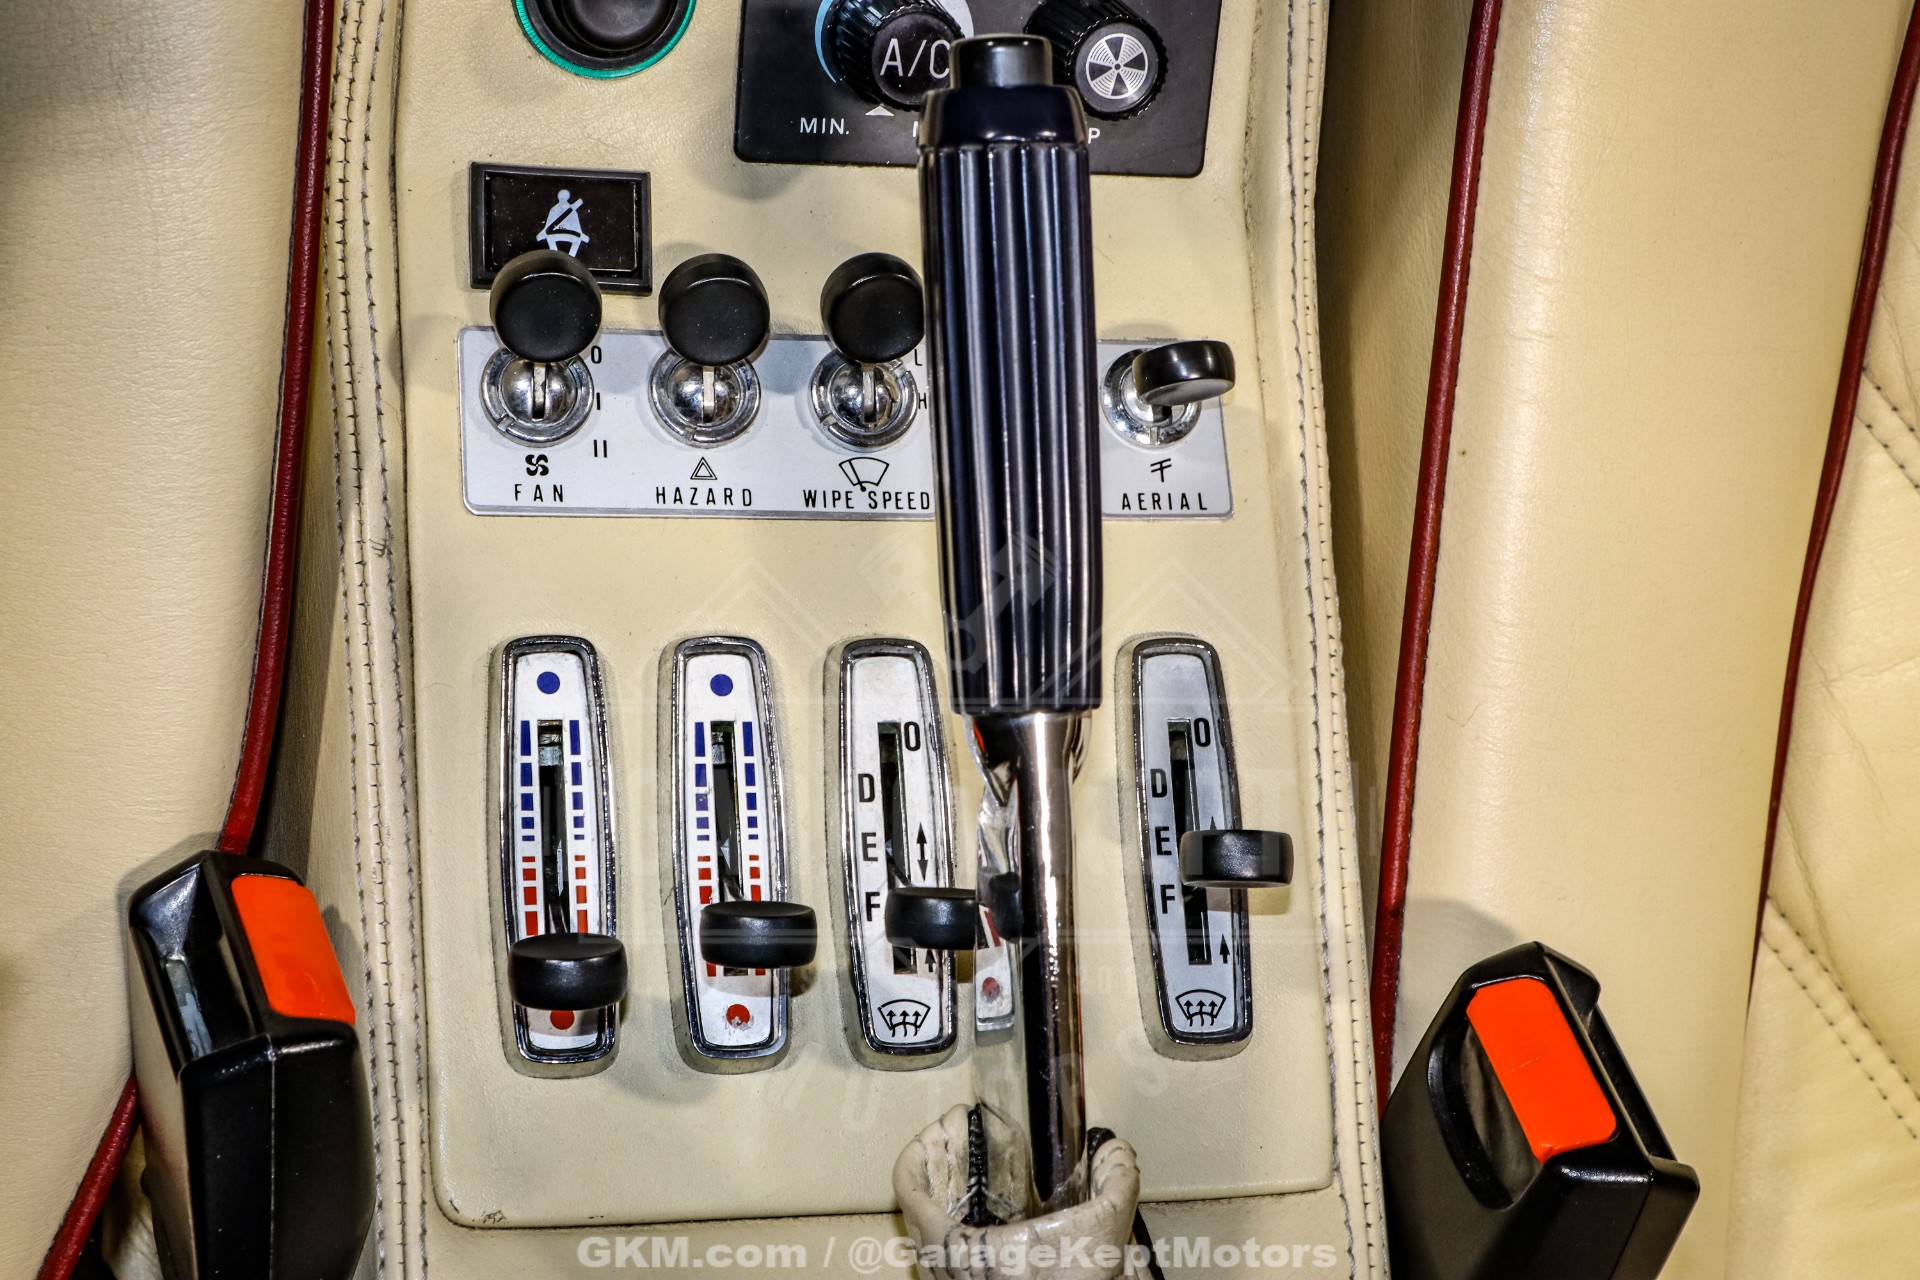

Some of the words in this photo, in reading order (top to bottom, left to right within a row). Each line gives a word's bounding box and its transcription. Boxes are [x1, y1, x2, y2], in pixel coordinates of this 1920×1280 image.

[880, 37, 950, 79] A/C
[800, 117, 850, 135] MIN.
[514, 483, 564, 503] FAN
[655, 486, 753, 508] HAZARD
[802, 490, 855, 509] WIPE
[867, 490, 931, 511] SPEED
[1121, 492, 1208, 511] AERIAL
